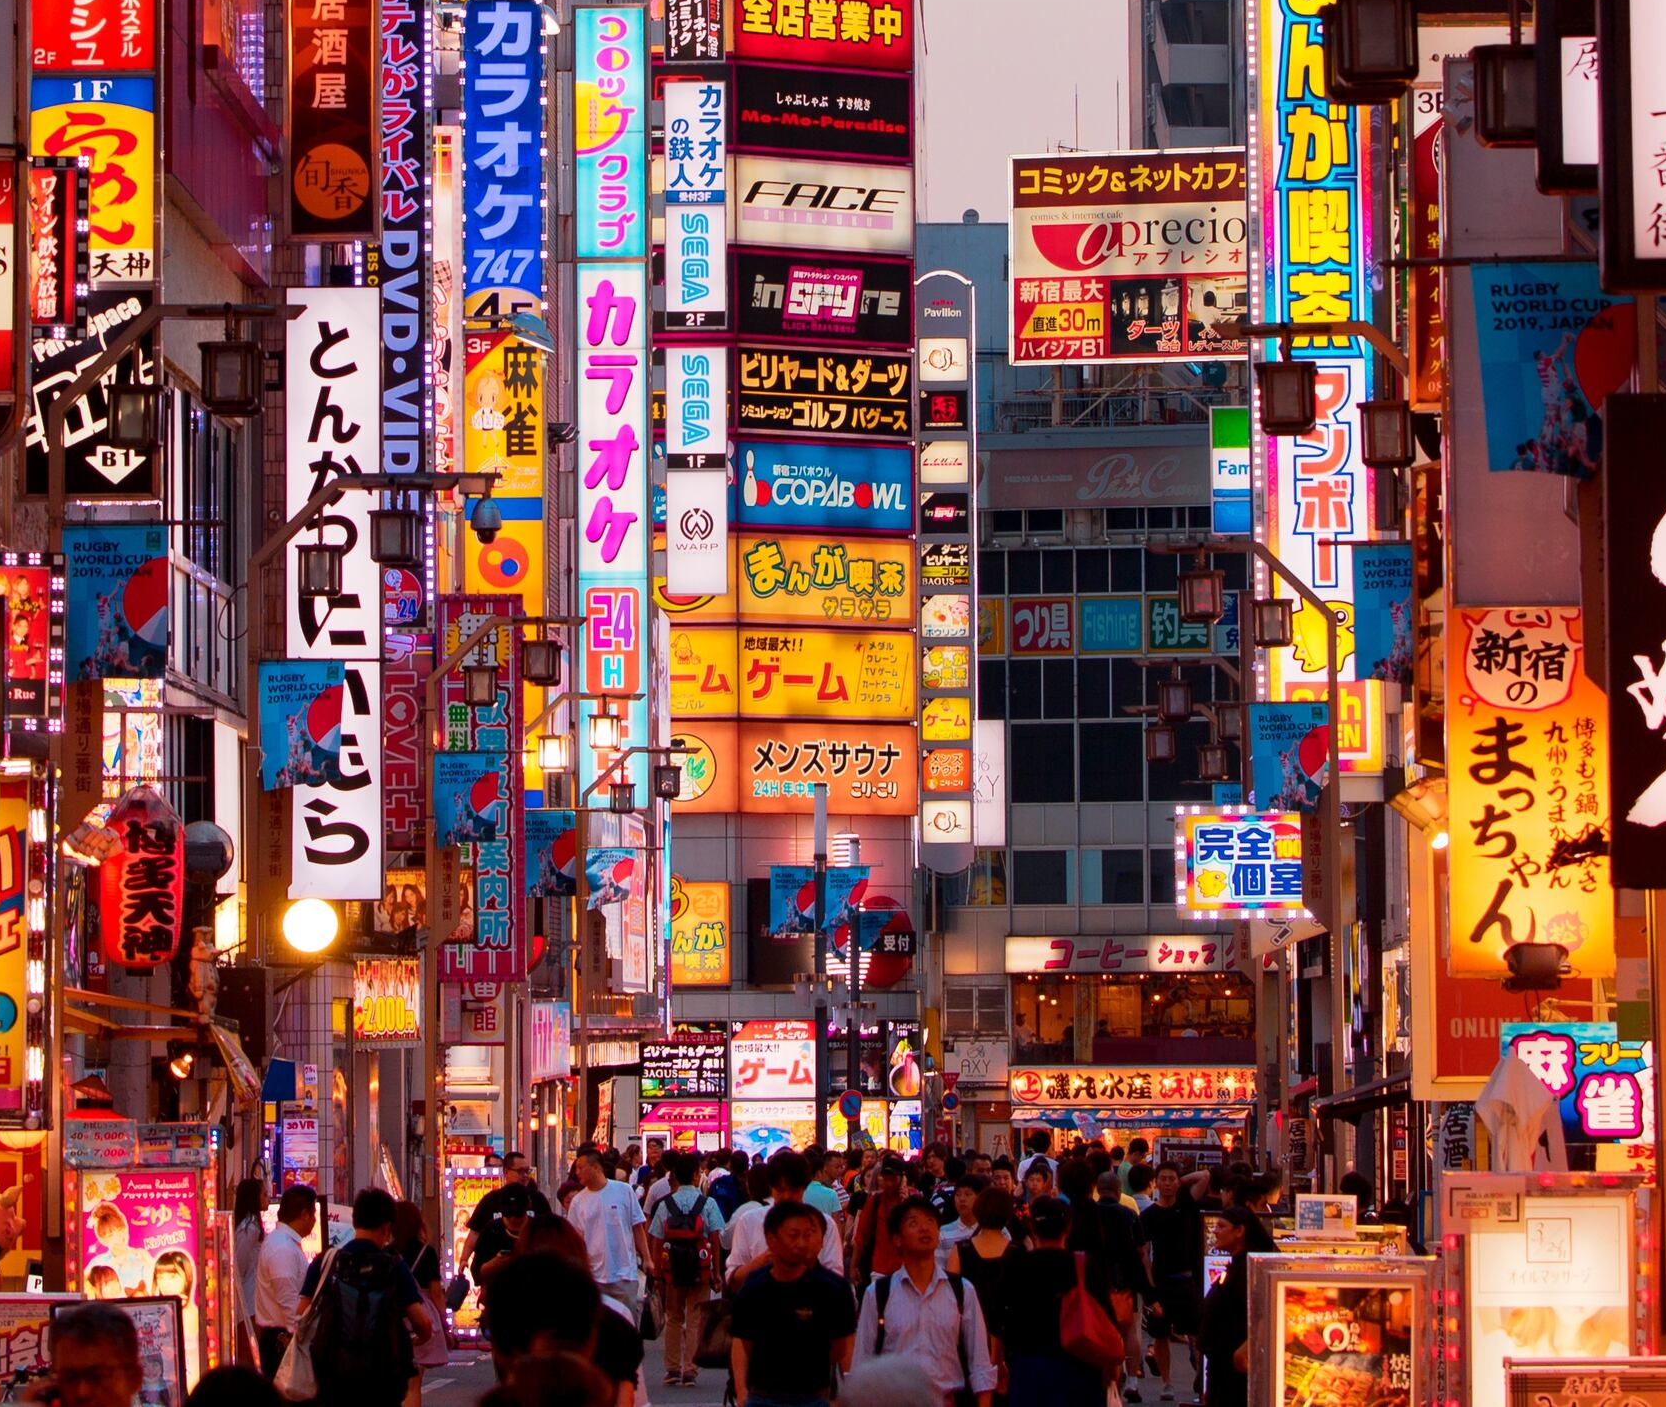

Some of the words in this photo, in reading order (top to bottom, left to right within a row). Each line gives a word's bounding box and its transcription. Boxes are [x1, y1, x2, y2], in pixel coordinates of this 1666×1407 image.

[33, 47, 56, 65] 2F
[71, 80, 113, 102] 1F
[776, 92, 829, 107] しゃぶしゃぶ
[836, 96, 872, 111] すき焼き
[475, 2, 533, 242] カラオケ
[595, 14, 636, 249] コロッケクラブ
[741, 110, 907, 135] Mo-Mo-Paradise
[699, 85, 723, 187] カラオケ
[669, 118, 695, 188] の鉄人
[743, 180, 906, 214] FACE
[35, 174, 61, 320] ワイン飲み放題
[681, 213, 710, 304] SEGA
[91, 252, 152, 280] 天神
[471, 249, 534, 284] 747
[1020, 280, 1104, 303] 新宿最大
[1491, 284, 1559, 296] RUGBY
[685, 313, 706, 326] 2F
[924, 308, 962, 319] Pavilion
[1492, 300, 1567, 314] WORLD
[1570, 300, 1612, 313] CUP
[467, 338, 492, 354] 3F
[1020, 337, 1104, 357] ハイジアB1
[741, 354, 909, 393] ビリヤード&ダーツ
[503, 343, 540, 458] 麻雀
[681, 354, 710, 446] SEGA
[584, 279, 639, 564] カラオケ
[741, 404, 793, 420] シミュレーション
[792, 400, 847, 429] ゴルフ
[851, 407, 908, 432] バグース
[101, 451, 136, 469] B1
[687, 455, 706, 468] 1F
[772, 464, 832, 478] 新宿コパボウル
[73, 541, 120, 552] RUGBY
[676, 542, 719, 551] WARP
[73, 555, 119, 566] WORLD
[122, 555, 152, 566] CUP
[744, 540, 906, 597] まんが喫茶
[823, 597, 892, 621] ゲラゲラ
[1014, 607, 1071, 651] つり具
[1084, 605, 1137, 643] Fishing
[744, 636, 804, 653] 地域最大!!
[268, 675, 305, 684] RUGBY
[747, 659, 850, 703] ゲーム
[1258, 714, 1293, 723] RUGBY
[753, 742, 902, 775] メンズサウナ
[1468, 714, 1543, 946] まっちゃん
[884, 934, 910, 952] 受付
[739, 1058, 814, 1086] ゲーム
[1047, 1071, 1153, 1101] 磯丸水産
